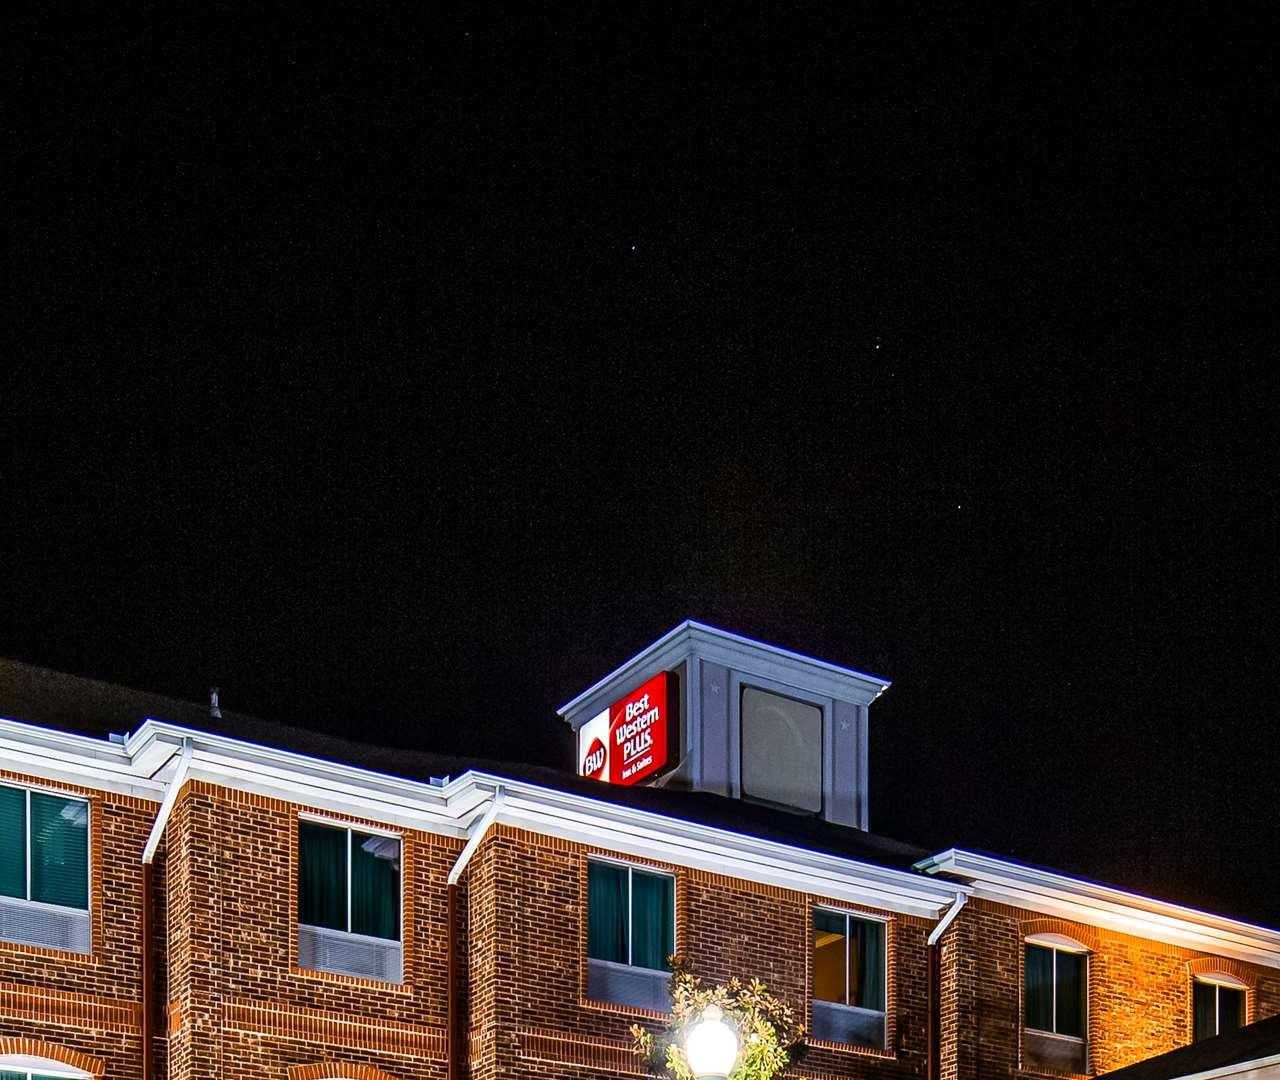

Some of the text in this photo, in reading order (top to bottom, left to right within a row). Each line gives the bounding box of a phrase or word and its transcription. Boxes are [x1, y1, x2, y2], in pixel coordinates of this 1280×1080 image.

[625, 694, 650, 722] Best
[615, 706, 659, 746] Western
[585, 747, 605, 775] BW
